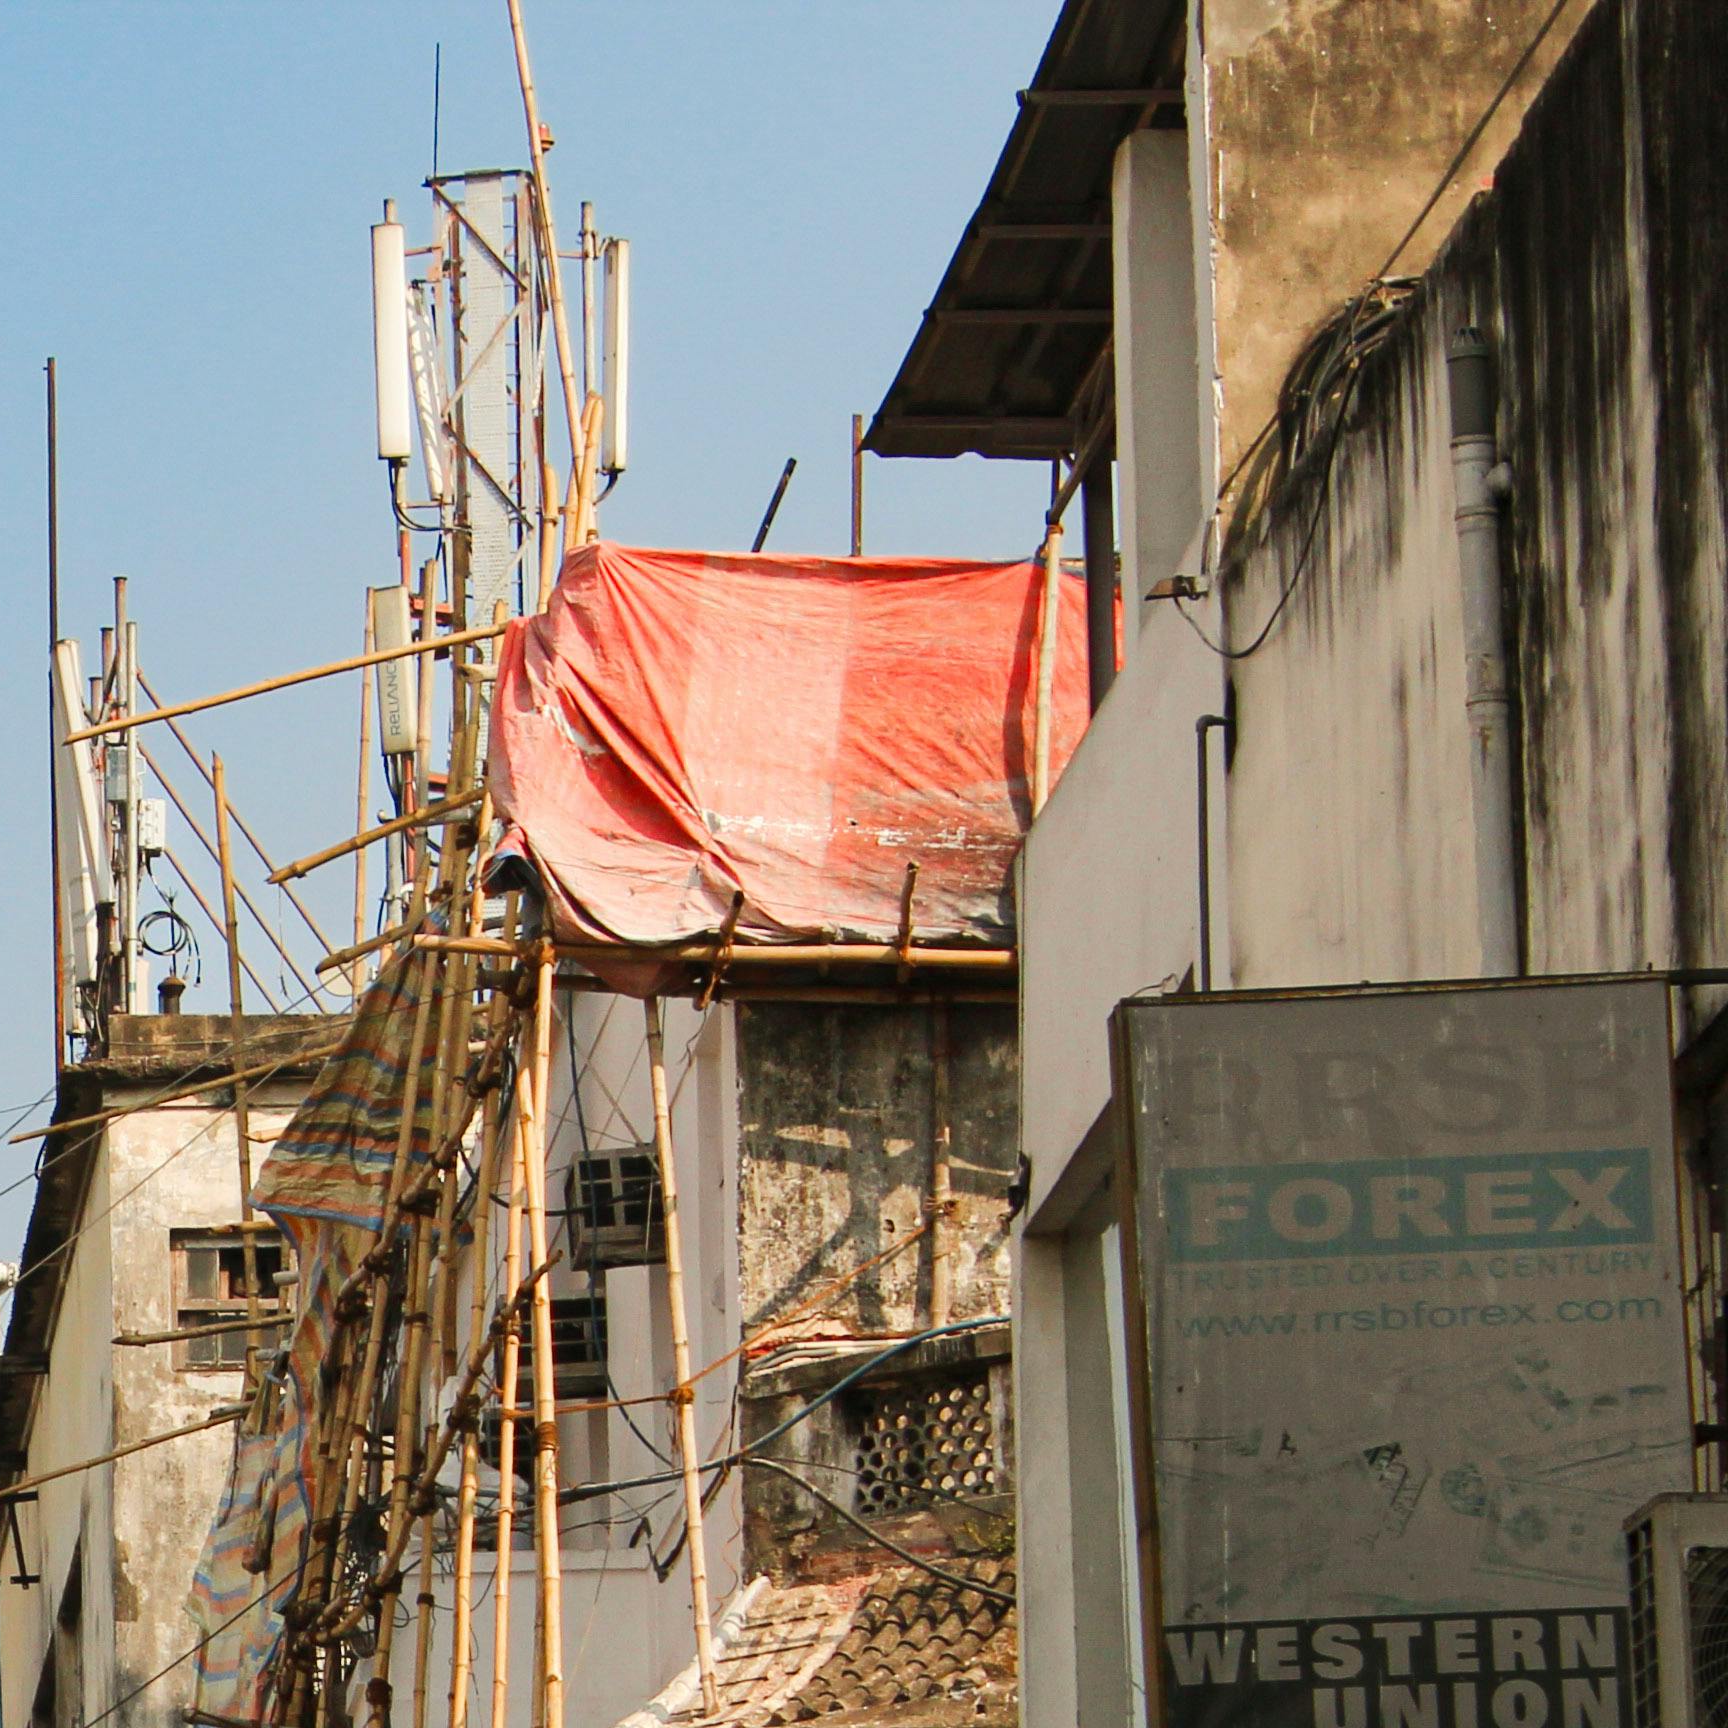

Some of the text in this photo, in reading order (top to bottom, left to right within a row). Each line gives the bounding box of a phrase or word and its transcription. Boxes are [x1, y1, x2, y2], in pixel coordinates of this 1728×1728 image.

[1187, 1165, 1637, 1247] FOREX
[1170, 1252, 1651, 1293] TRUSTED OVER A CENTURY
[1174, 1295, 1664, 1340] www.rrsbforex.com
[1165, 1613, 1618, 1688] WESTERN
